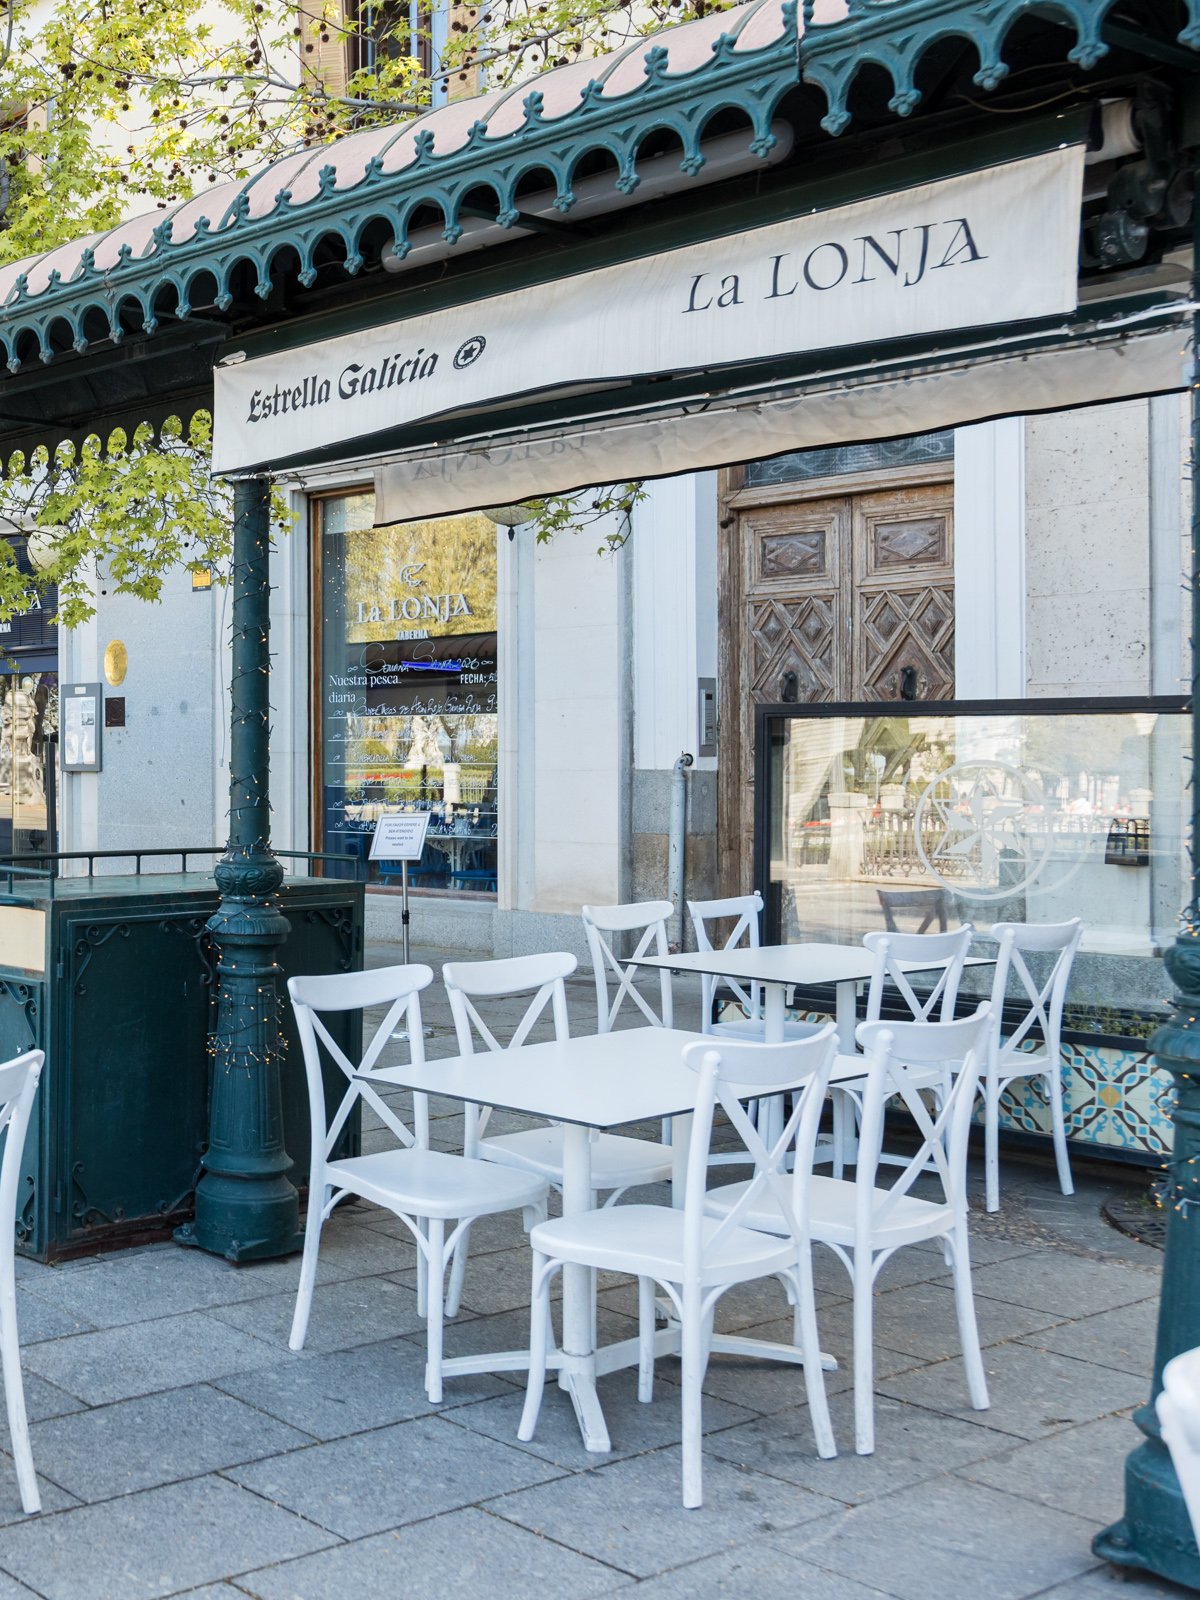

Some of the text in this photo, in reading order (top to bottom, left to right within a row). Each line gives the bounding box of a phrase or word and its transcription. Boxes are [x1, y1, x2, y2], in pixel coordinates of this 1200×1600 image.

[681, 217, 989, 313] La LONJA
[246, 374, 331, 423] Estrella
[338, 348, 439, 400] Galicia
[356, 593, 473, 624] La LONJA
[396, 629, 429, 640] TABERNA
[329, 675, 367, 686] Nuestra
[460, 673, 487, 684] FECHA:
[328, 692, 356, 704] diaria
